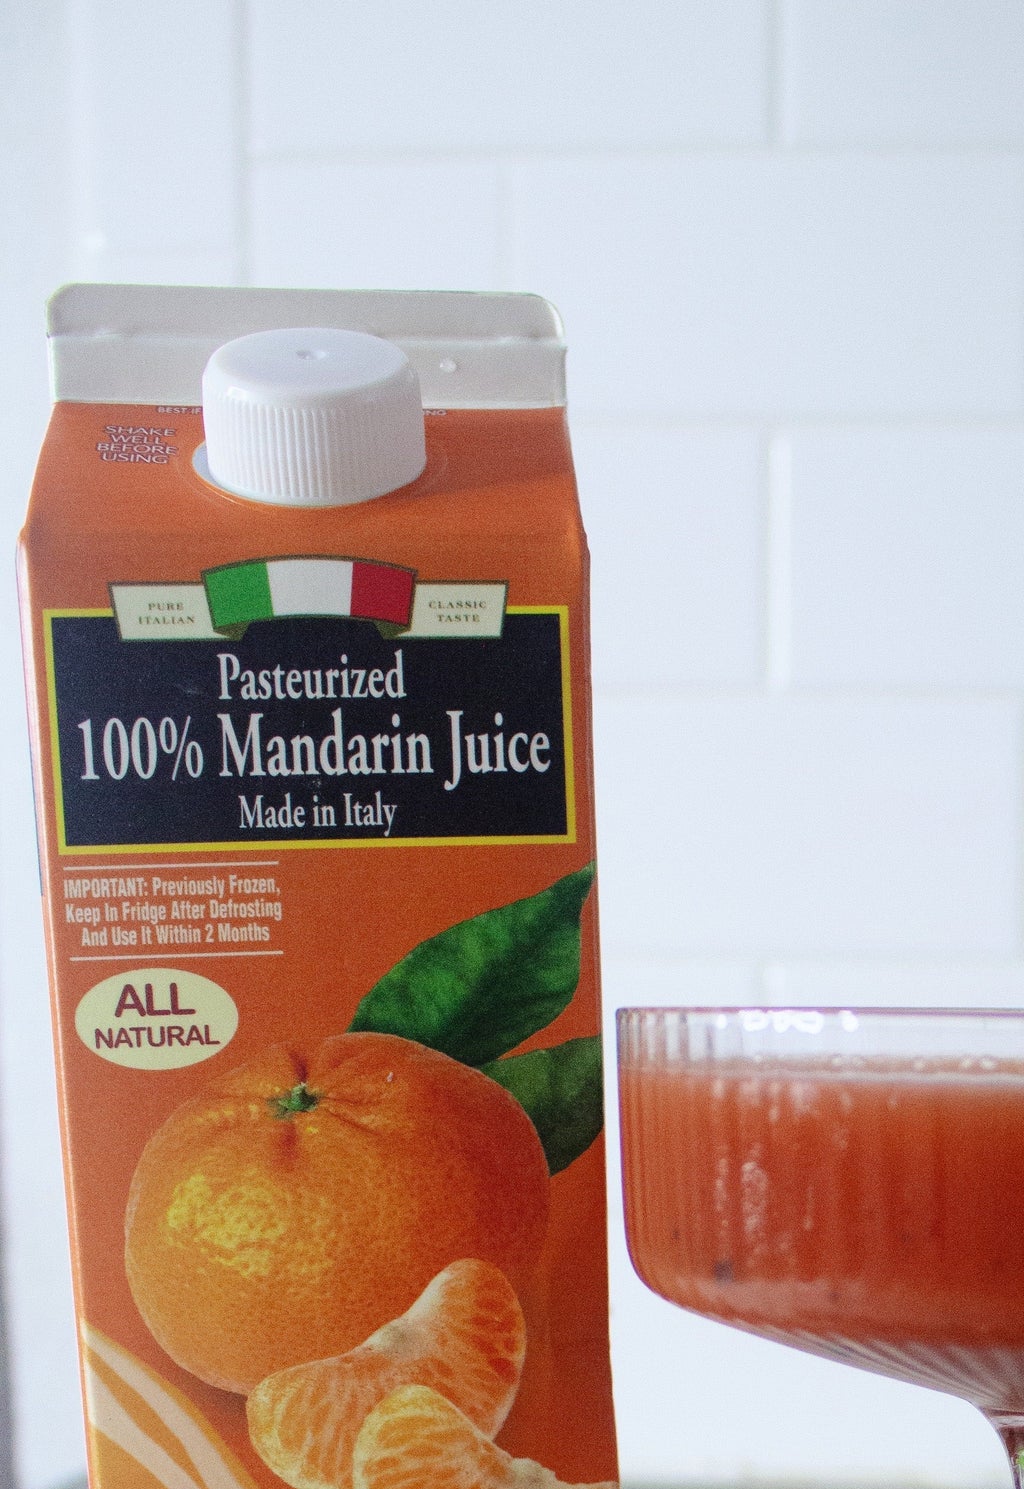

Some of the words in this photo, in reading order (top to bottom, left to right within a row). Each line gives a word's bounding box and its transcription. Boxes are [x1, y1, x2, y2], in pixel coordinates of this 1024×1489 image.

[105, 425, 177, 437] SHAKE
[110, 434, 164, 445] WELL
[97, 443, 178, 455] BEFORE
[102, 453, 169, 464] USING
[147, 602, 184, 611] PURE
[428, 600, 487, 609] CLASSIC
[138, 615, 196, 625] ITALIAN
[437, 614, 481, 623] TASTE
[216, 649, 407, 700] Pasteurized
[77, 715, 204, 781] 100%
[217, 708, 434, 777] Mandarin
[444, 710, 551, 791] Juice
[238, 793, 306, 829] Made
[313, 795, 337, 827] in
[343, 791, 398, 837] Italy
[63, 877, 149, 899] IMPORTANT:
[152, 875, 226, 898] Previously
[229, 874, 281, 896] Frozen,
[65, 903, 101, 926] Keep
[104, 902, 119, 922] In
[122, 901, 167, 924] Fridge
[171, 900, 206, 920] After
[210, 898, 283, 922] Defrosting
[81, 927, 108, 947] And
[111, 926, 138, 946] Use
[141, 925, 153, 945] It
[156, 924, 201, 944] Within
[205, 923, 214, 943] 2
[217, 922, 270, 943] Months
[114, 982, 196, 1018] ALL
[94, 1025, 221, 1049] NATURAL
